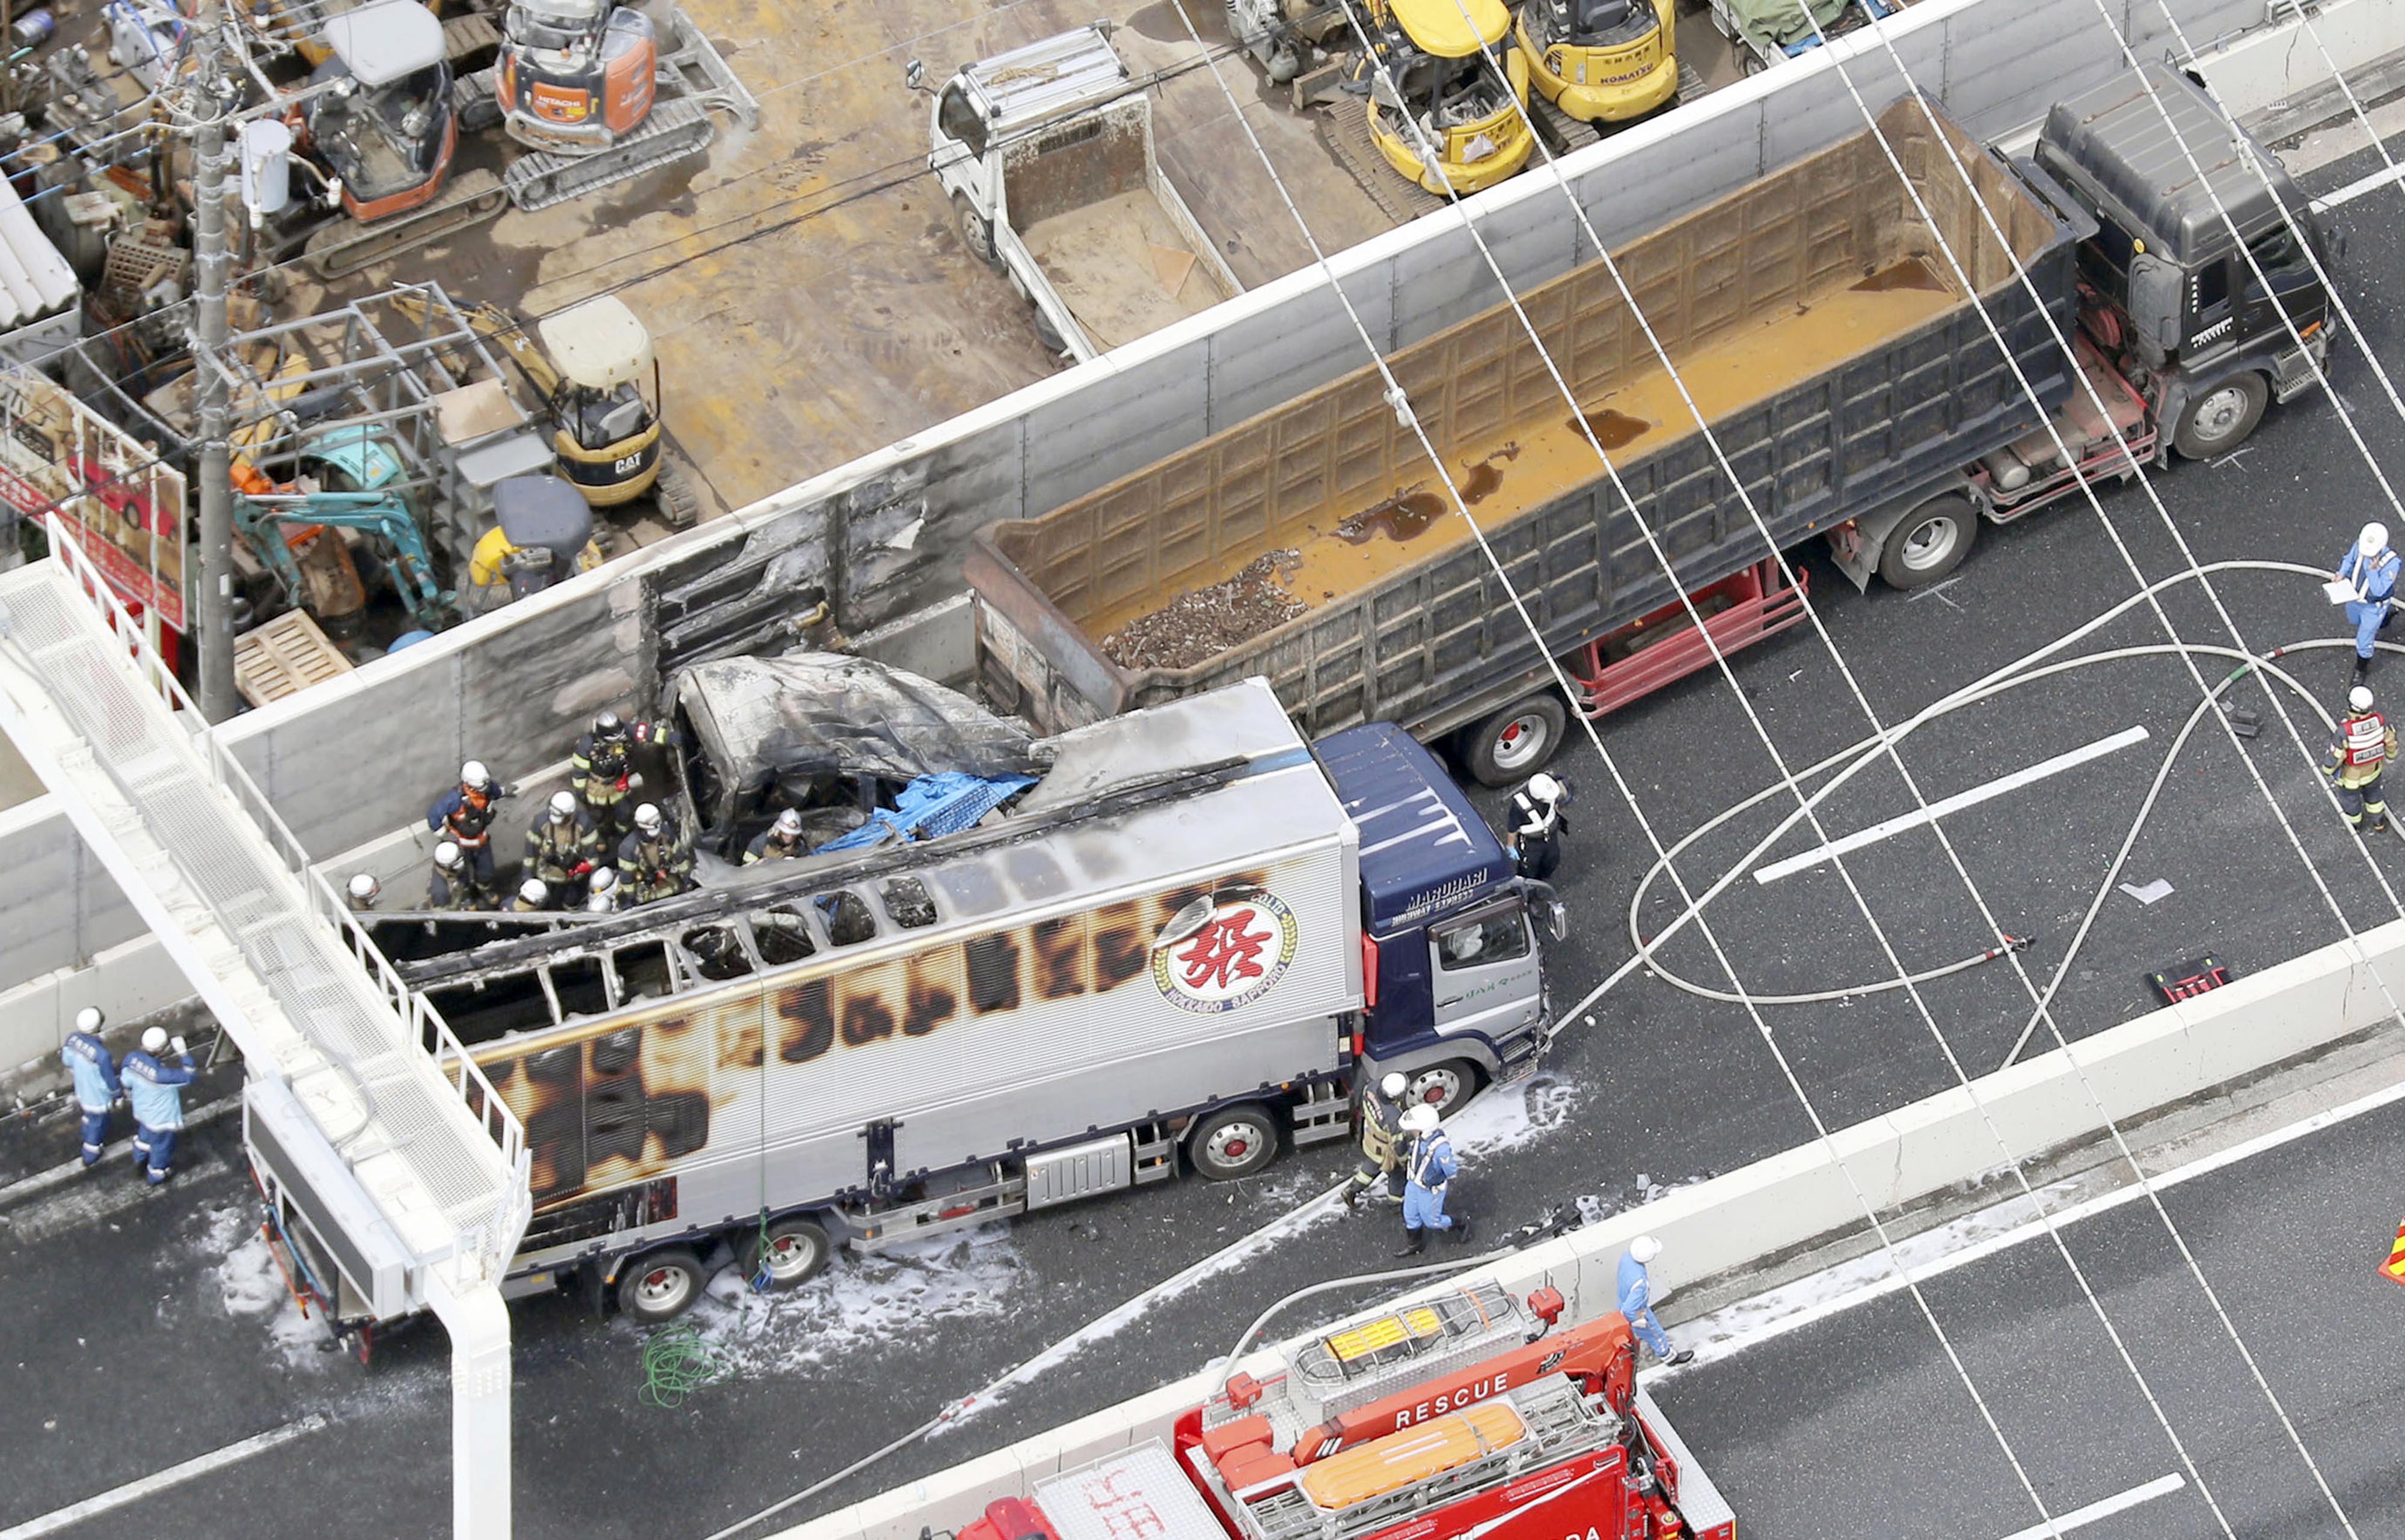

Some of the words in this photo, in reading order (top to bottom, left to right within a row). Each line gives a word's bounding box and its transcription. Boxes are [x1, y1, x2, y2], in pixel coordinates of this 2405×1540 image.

[1600, 63, 1653, 84] KOMATSU
[538, 95, 581, 107] HITACHI
[615, 451, 642, 474] CAT
[1391, 903, 1431, 927] HIGHWAY
[1434, 889, 1474, 912] EXPRESS
[1405, 867, 1487, 912] MARUHARI
[1166, 989, 1224, 1013] HOKKAIDO
[1231, 962, 1287, 1008] SAPPORO
[1395, 1372, 1509, 1429] RESCUE
